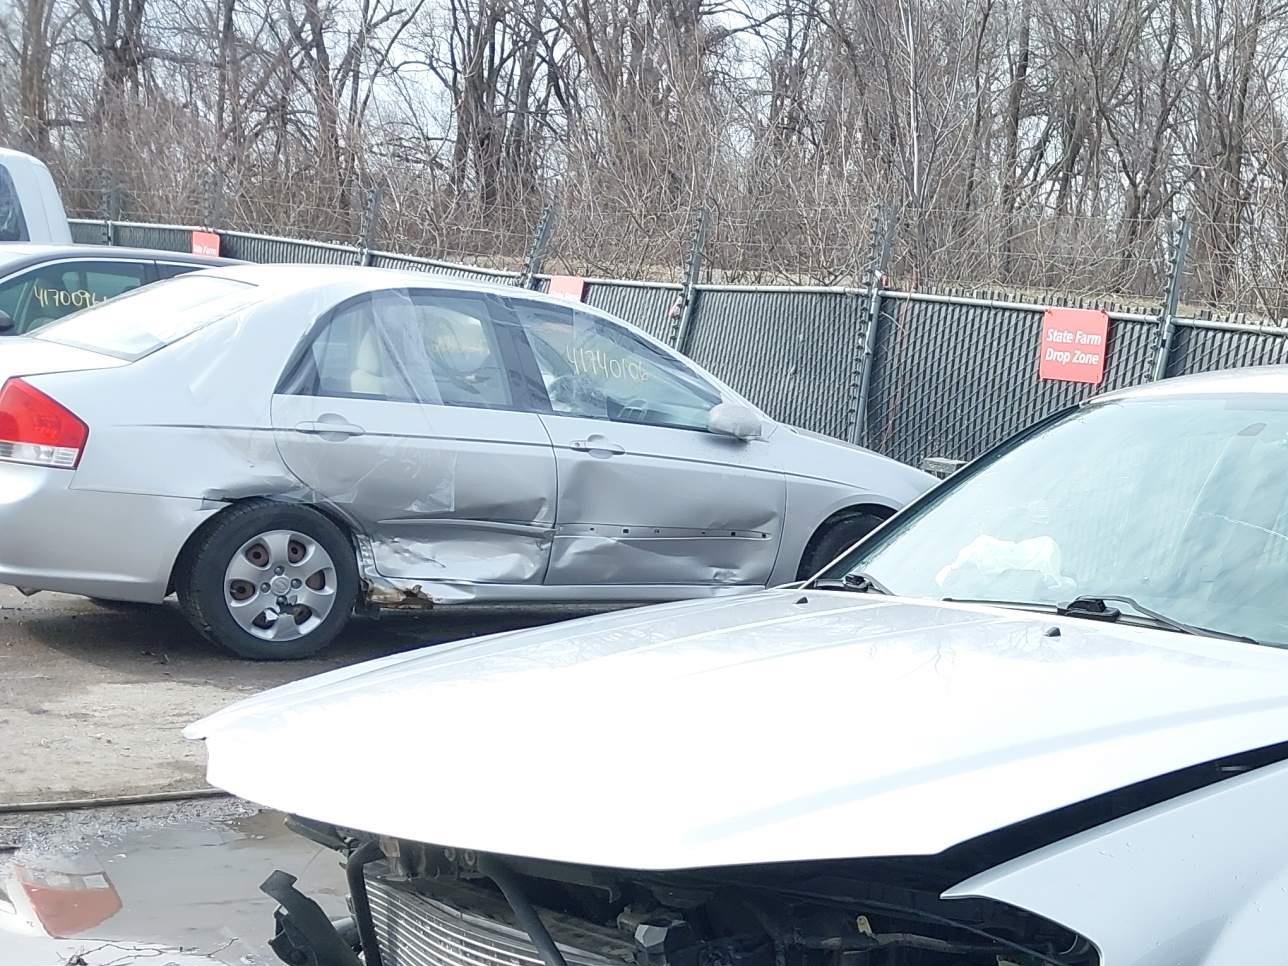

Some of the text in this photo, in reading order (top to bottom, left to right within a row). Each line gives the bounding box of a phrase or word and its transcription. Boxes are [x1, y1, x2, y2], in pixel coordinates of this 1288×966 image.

[1046, 328, 1101, 345] State Farm
[1045, 348, 1099, 365] Drop Zone
